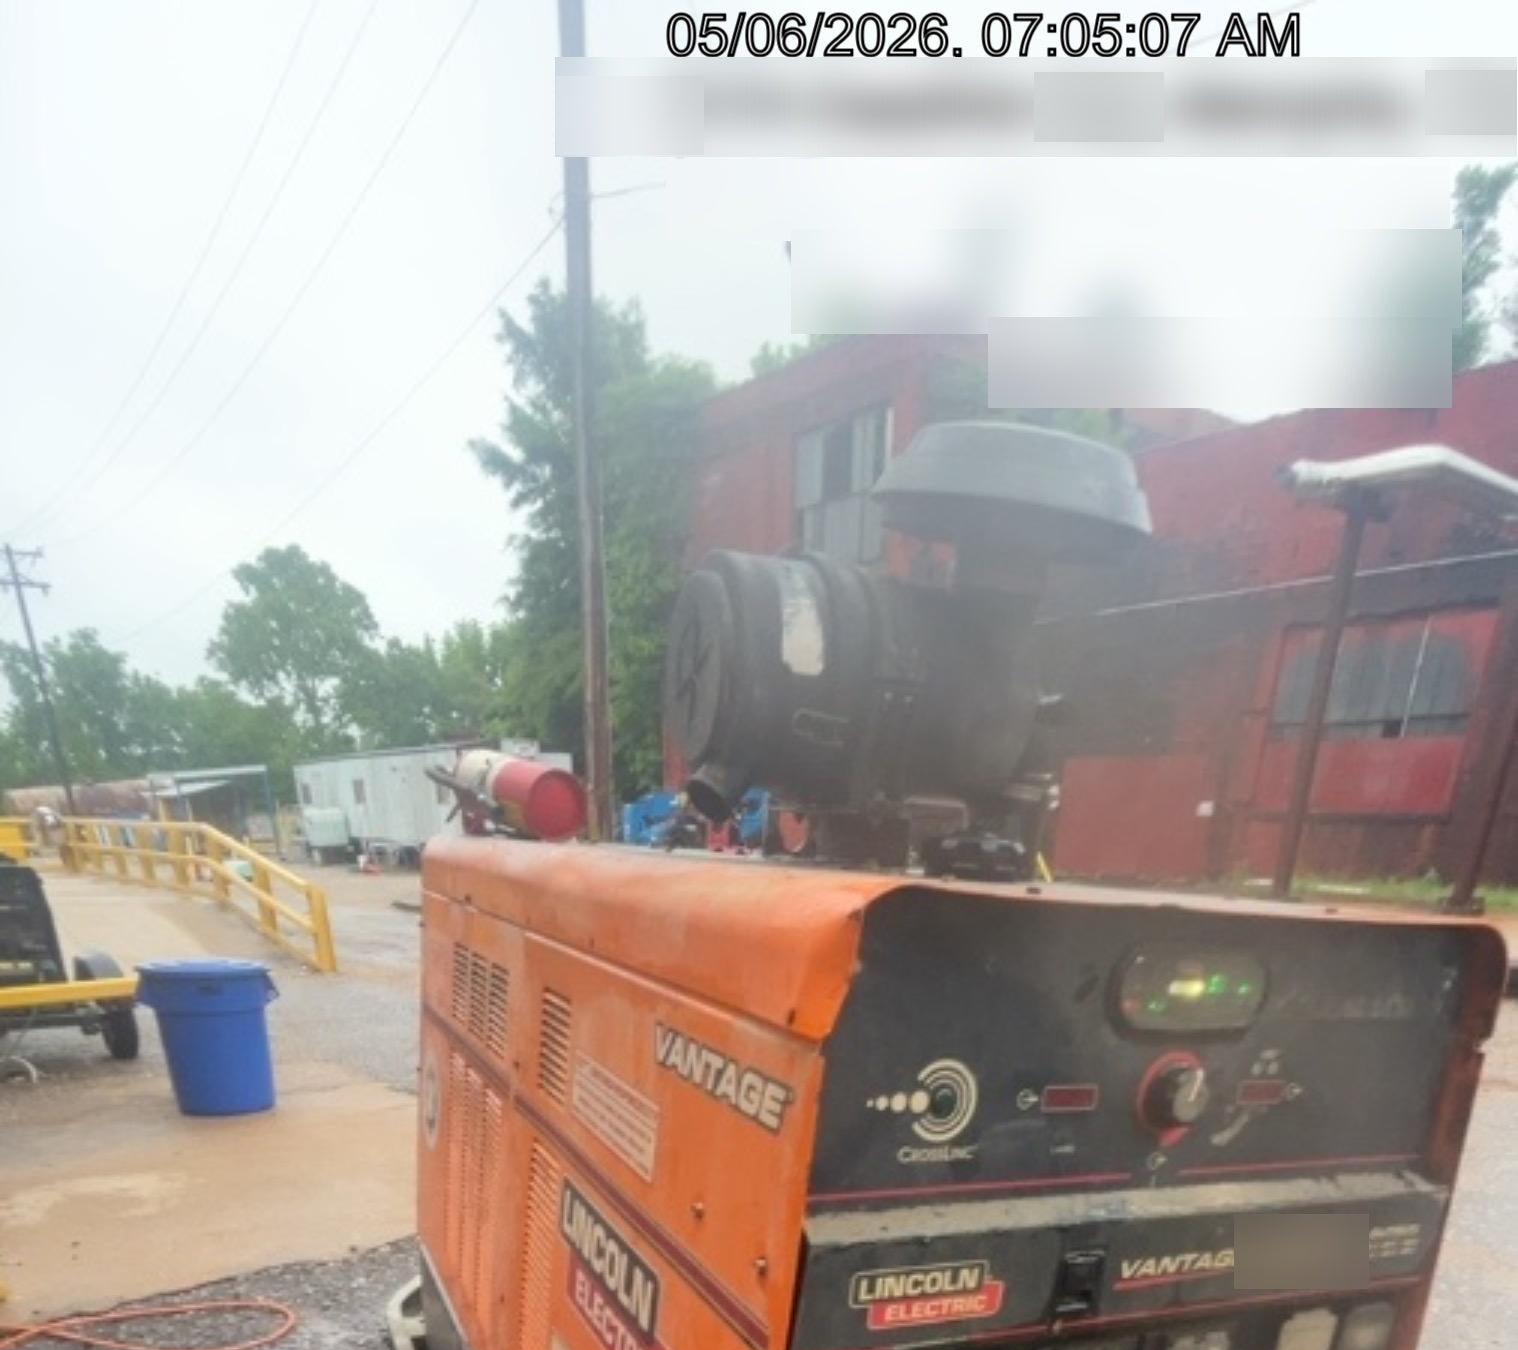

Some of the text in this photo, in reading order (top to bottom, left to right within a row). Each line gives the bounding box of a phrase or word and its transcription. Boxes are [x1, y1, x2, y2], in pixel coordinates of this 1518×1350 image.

[654, 1023, 787, 1134] VANTAGE
[564, 1188, 656, 1330] LINCOLN
[1120, 1248, 1235, 1280] VANTAG
[858, 1266, 980, 1301] LINCOLN
[883, 1296, 987, 1322] ELECTRIC
